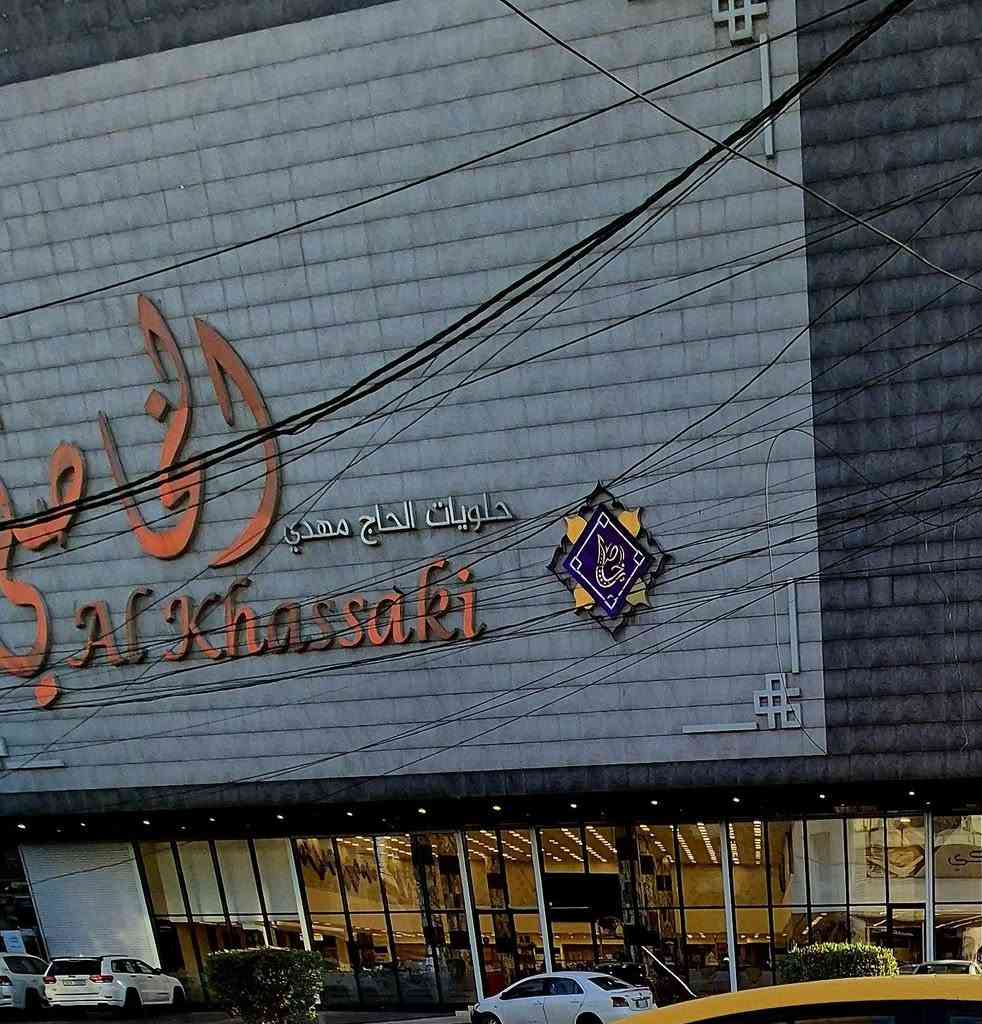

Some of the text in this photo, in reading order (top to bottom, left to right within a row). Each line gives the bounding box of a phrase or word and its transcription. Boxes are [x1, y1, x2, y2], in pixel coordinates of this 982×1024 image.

[284, 492, 513, 554] حلويات الحاج مهدي
[66, 584, 153, 671] Al
[163, 559, 488, 664] Khassaki
